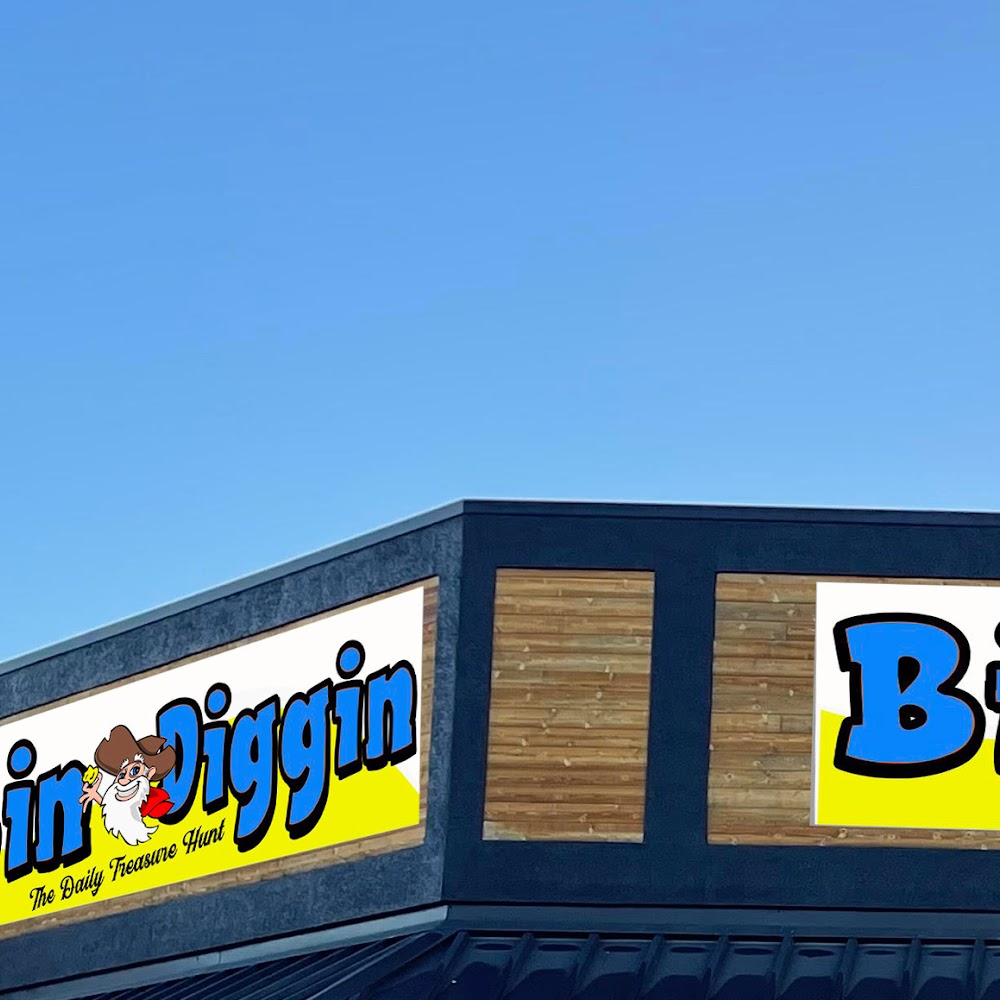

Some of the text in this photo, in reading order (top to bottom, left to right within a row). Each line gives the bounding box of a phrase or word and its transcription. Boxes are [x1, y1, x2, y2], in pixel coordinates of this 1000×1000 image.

[0, 640, 417, 883] in Diggin
[29, 817, 227, 912] The Daily Treasure Hunt
